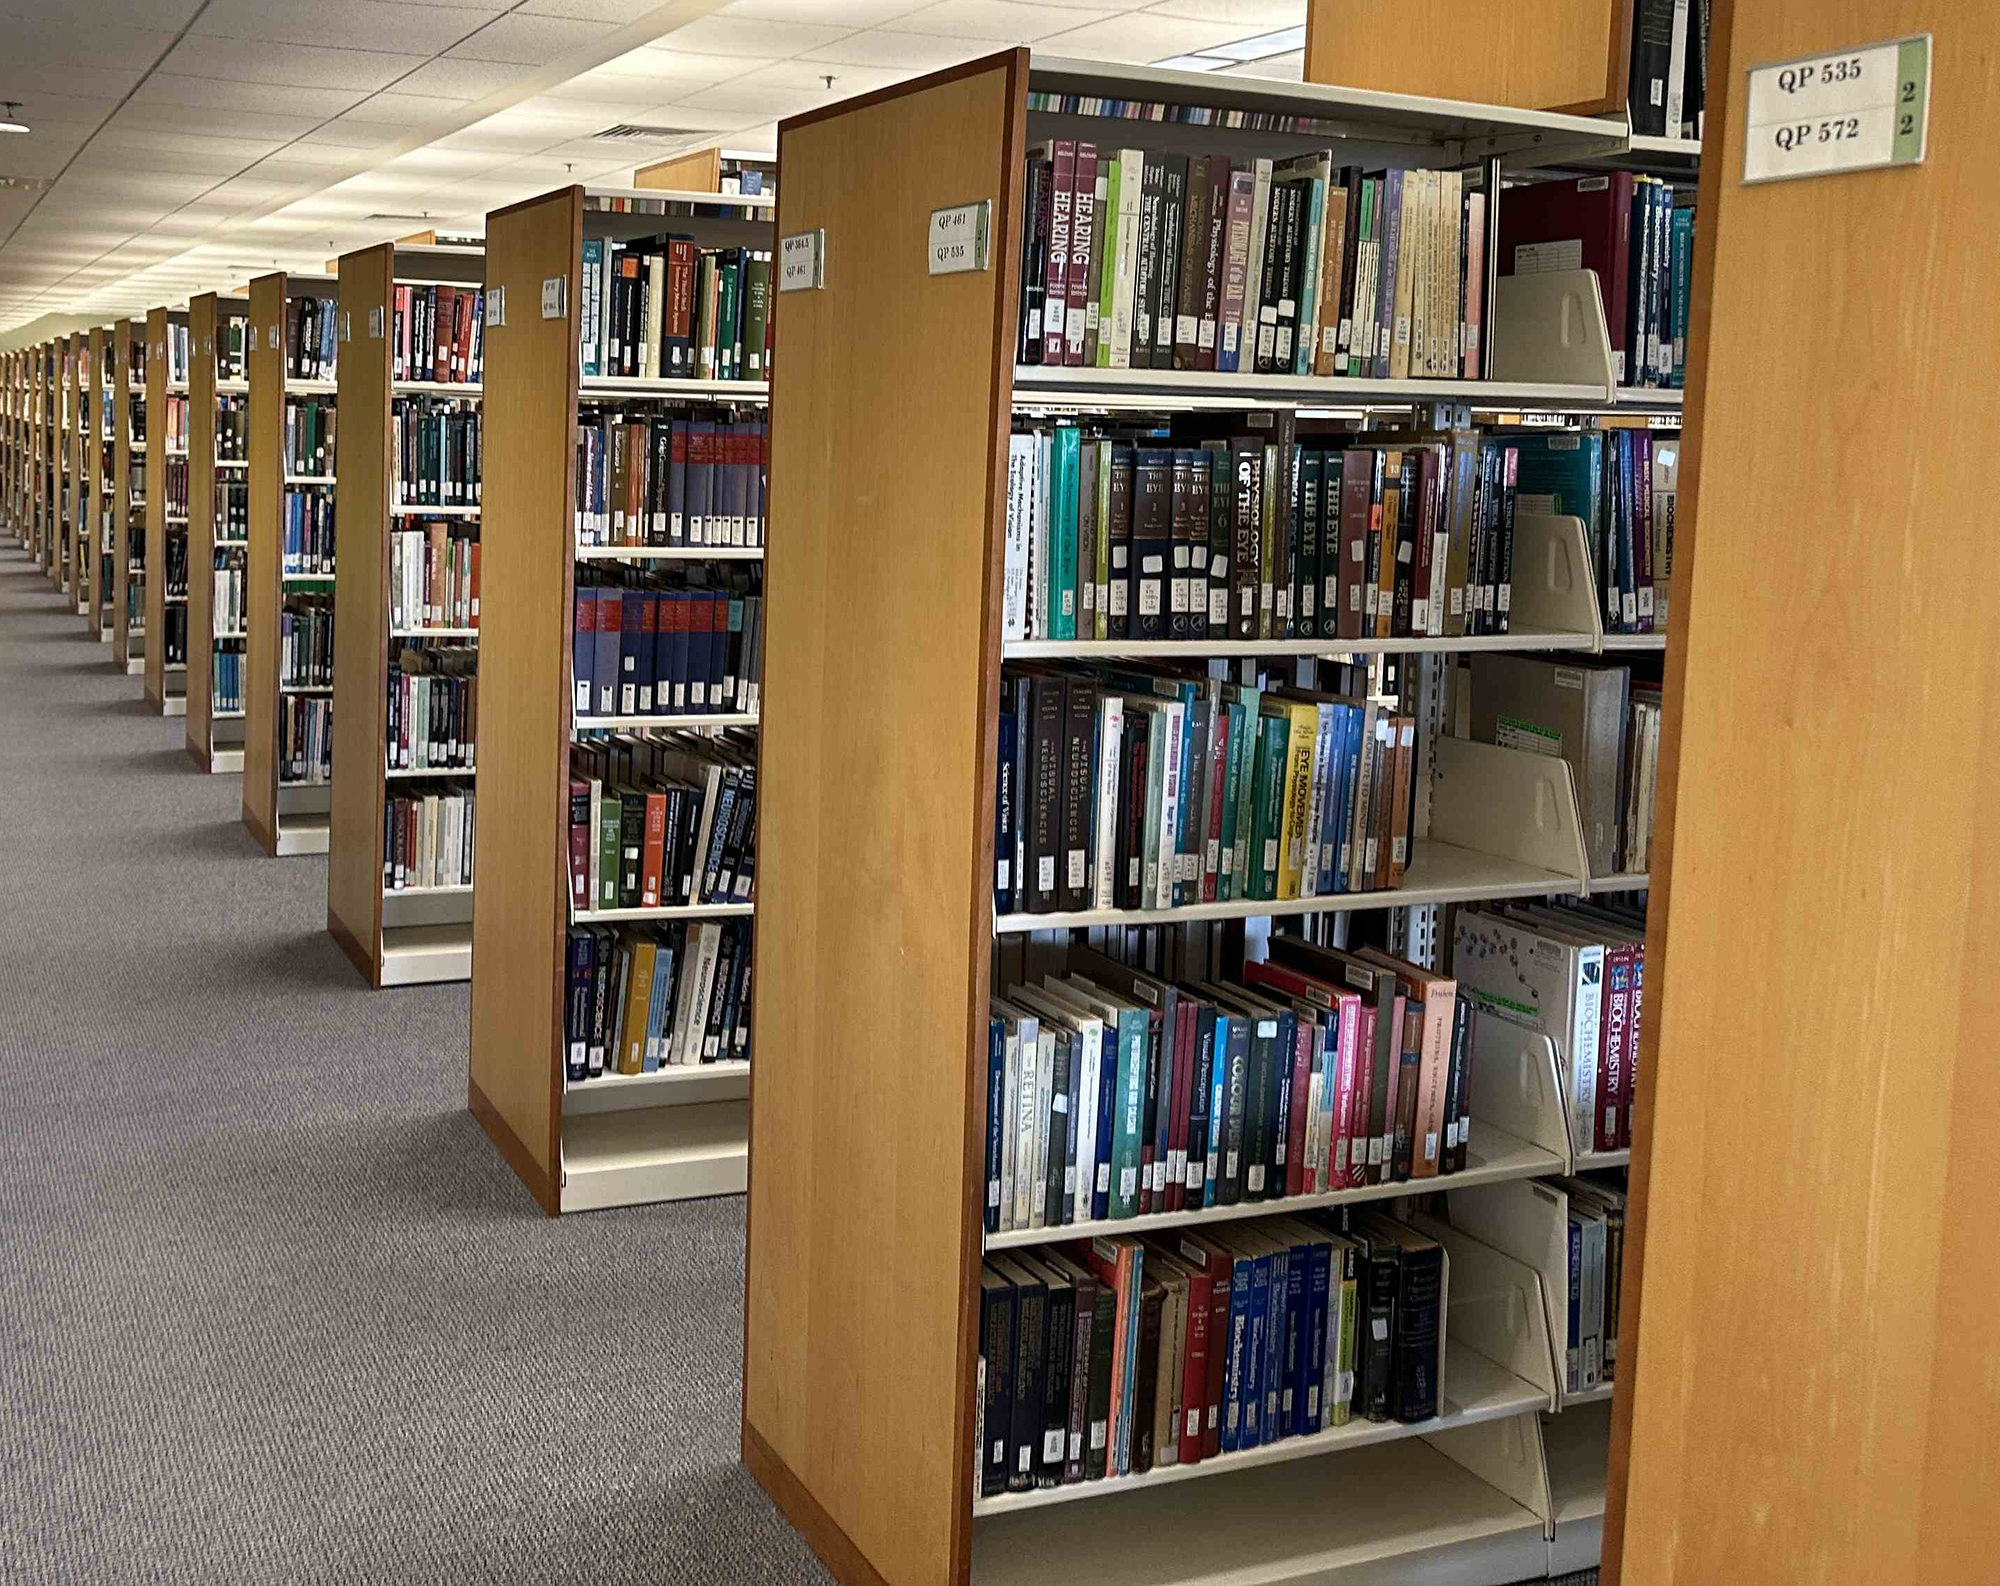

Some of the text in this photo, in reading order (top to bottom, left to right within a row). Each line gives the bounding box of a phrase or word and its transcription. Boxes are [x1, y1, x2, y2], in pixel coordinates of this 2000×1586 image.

[1779, 60, 1862, 93] QP 535
[1902, 82, 1916, 102] 2
[1776, 118, 1859, 151] QP 572
[1900, 114, 1913, 135] 2
[939, 215, 950, 229] QP
[1272, 187, 1280, 222] MODERN
[785, 240, 794, 252] QP
[1051, 190, 1070, 263] HEARING
[1073, 192, 1093, 265] HEARING
[1142, 215, 1150, 254] CENTRAL
[1208, 218, 1221, 275] Physiology
[1230, 220, 1248, 265] PHYSIOLOGY
[1268, 224, 1276, 264] AUDITORY
[1284, 225, 1292, 263] AUDITORY
[1651, 206, 1662, 279] Biochemistry
[1663, 208, 1671, 268] Biochemistry
[786, 265, 795, 278] QP
[937, 246, 964, 260] QP 535
[1140, 257, 1148, 295] AUDITORY
[1207, 278, 1216, 290] of
[1227, 284, 1243, 300] EAR
[1205, 292, 1214, 309] the
[1008, 471, 1016, 500] Ecology
[1017, 455, 1025, 489] Adaptive
[1198, 504, 1204, 513] 4
[1218, 514, 1226, 528] 6
[1237, 462, 1250, 563] OF THE EYE
[1250, 460, 1260, 566] PHYSIOLOGY
[1303, 480, 1316, 556] THE EYE
[1326, 478, 1340, 554] THE EYE
[1016, 544, 1022, 552] in
[1665, 495, 1674, 575] BIOCHEMISTRY
[1063, 558, 1071, 574] Eye
[1502, 532, 1512, 581] PERCEPTION
[1301, 750, 1310, 772] EYE
[1365, 731, 1374, 760] FROM
[1048, 755, 1056, 802] VISUAL
[1070, 737, 1080, 841] NEUROSCIENCES
[1080, 754, 1088, 799] VISUAL
[1231, 765, 1237, 774] of
[1001, 762, 1010, 833] Science of Vision
[1039, 740, 1048, 844] NEUROSCIENCES
[1291, 770, 1299, 811] Physiology
[1361, 784, 1370, 797] TO
[708, 789, 735, 872] NEUROSCIENCE
[1359, 800, 1368, 829] MIND
[594, 966, 606, 1039] NEUROSCIENCE
[694, 957, 711, 1025] Neuroscience
[712, 958, 729, 1025] NEUROSCIENCE
[740, 966, 751, 1002] Medicine
[1582, 992, 1594, 1104] BIOCHEMISTRY
[1607, 992, 1623, 1095] BIOCHEMISTRY
[1199, 1032, 1211, 1113] Visual Perception
[1230, 1056, 1244, 1114] COLOUR
[1022, 1070, 1034, 1132] RETINA
[1229, 1315, 1245, 1400] Biochemistry
[1248, 1317, 1260, 1390] Biochemistry
